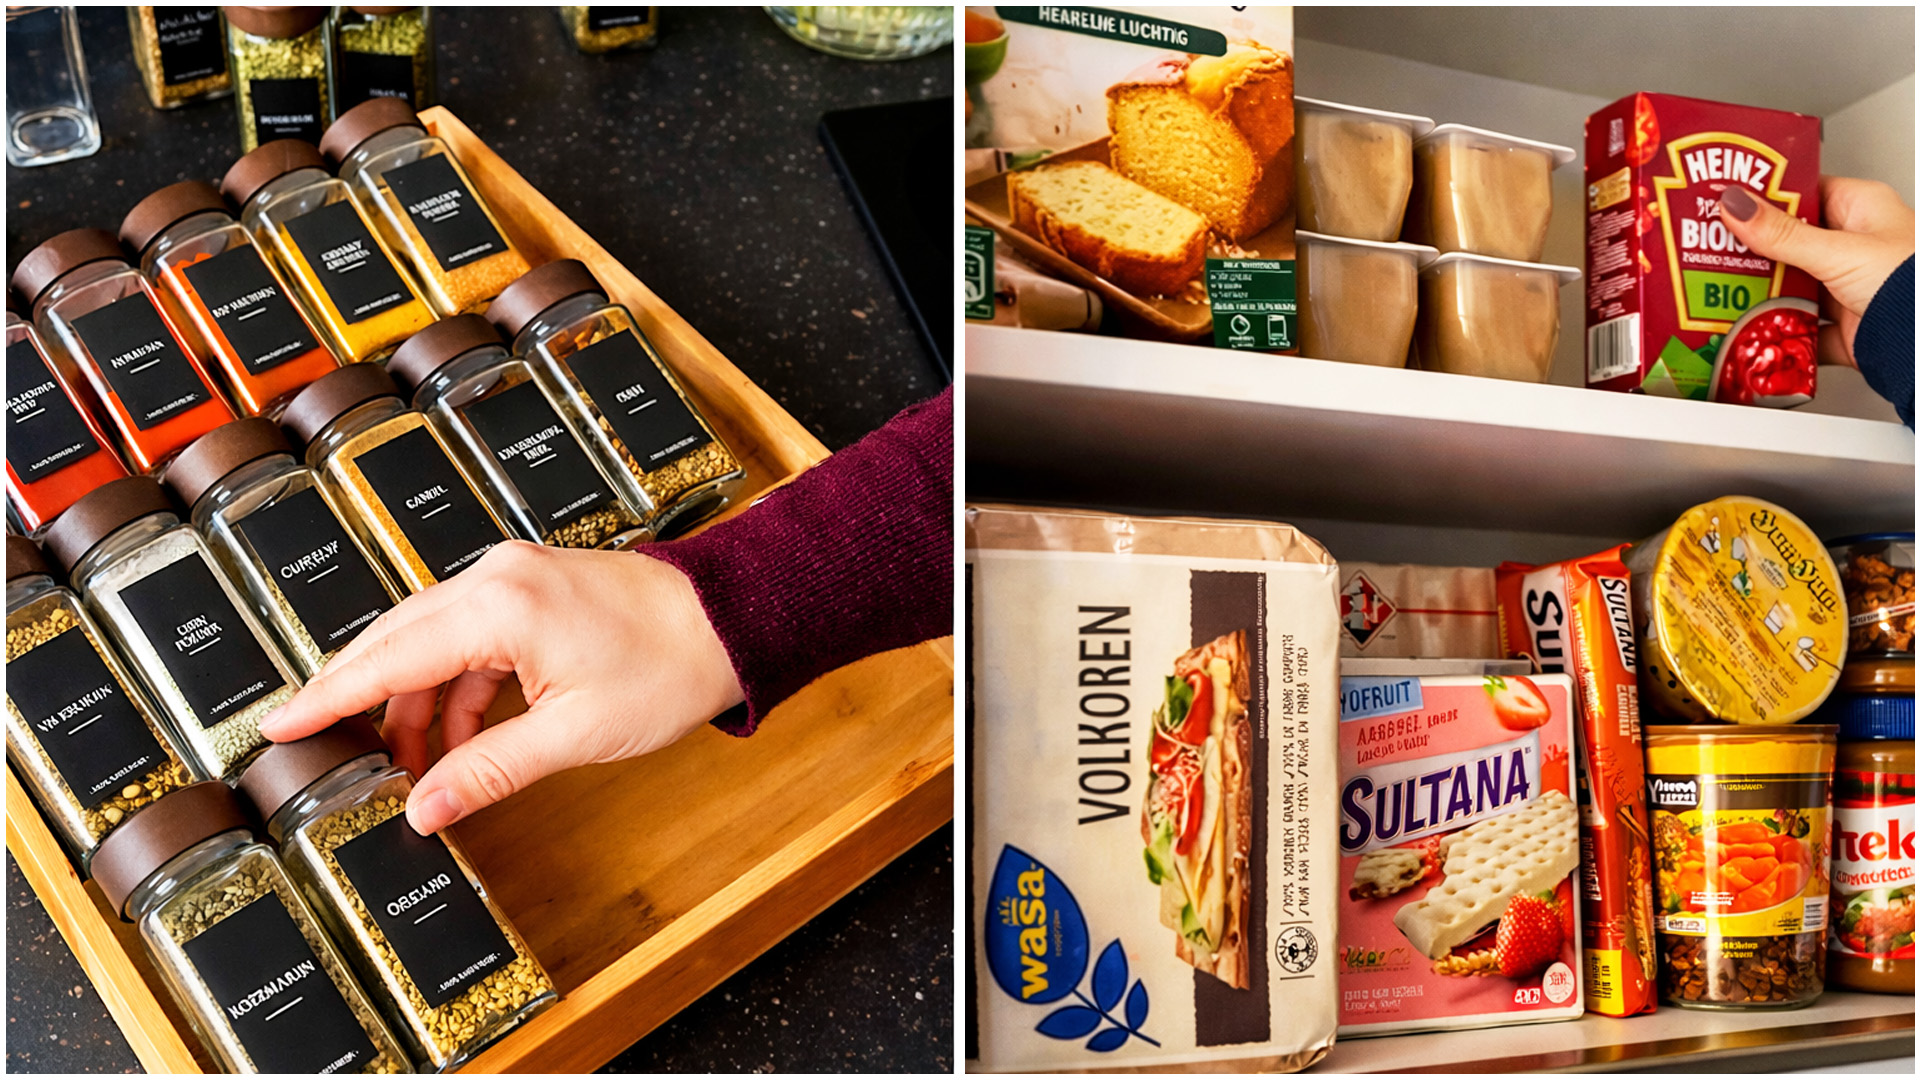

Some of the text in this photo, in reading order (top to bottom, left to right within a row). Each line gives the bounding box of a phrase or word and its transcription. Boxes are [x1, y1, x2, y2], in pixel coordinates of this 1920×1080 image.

[1685, 147, 1772, 191] HEINZ
[1704, 282, 1751, 311] BIO
[1077, 604, 1132, 826] VOLKOREN
[1340, 680, 1411, 715] YOFRUIT
[1339, 747, 1531, 853] SULTANA
[1017, 868, 1050, 1000] wasa
